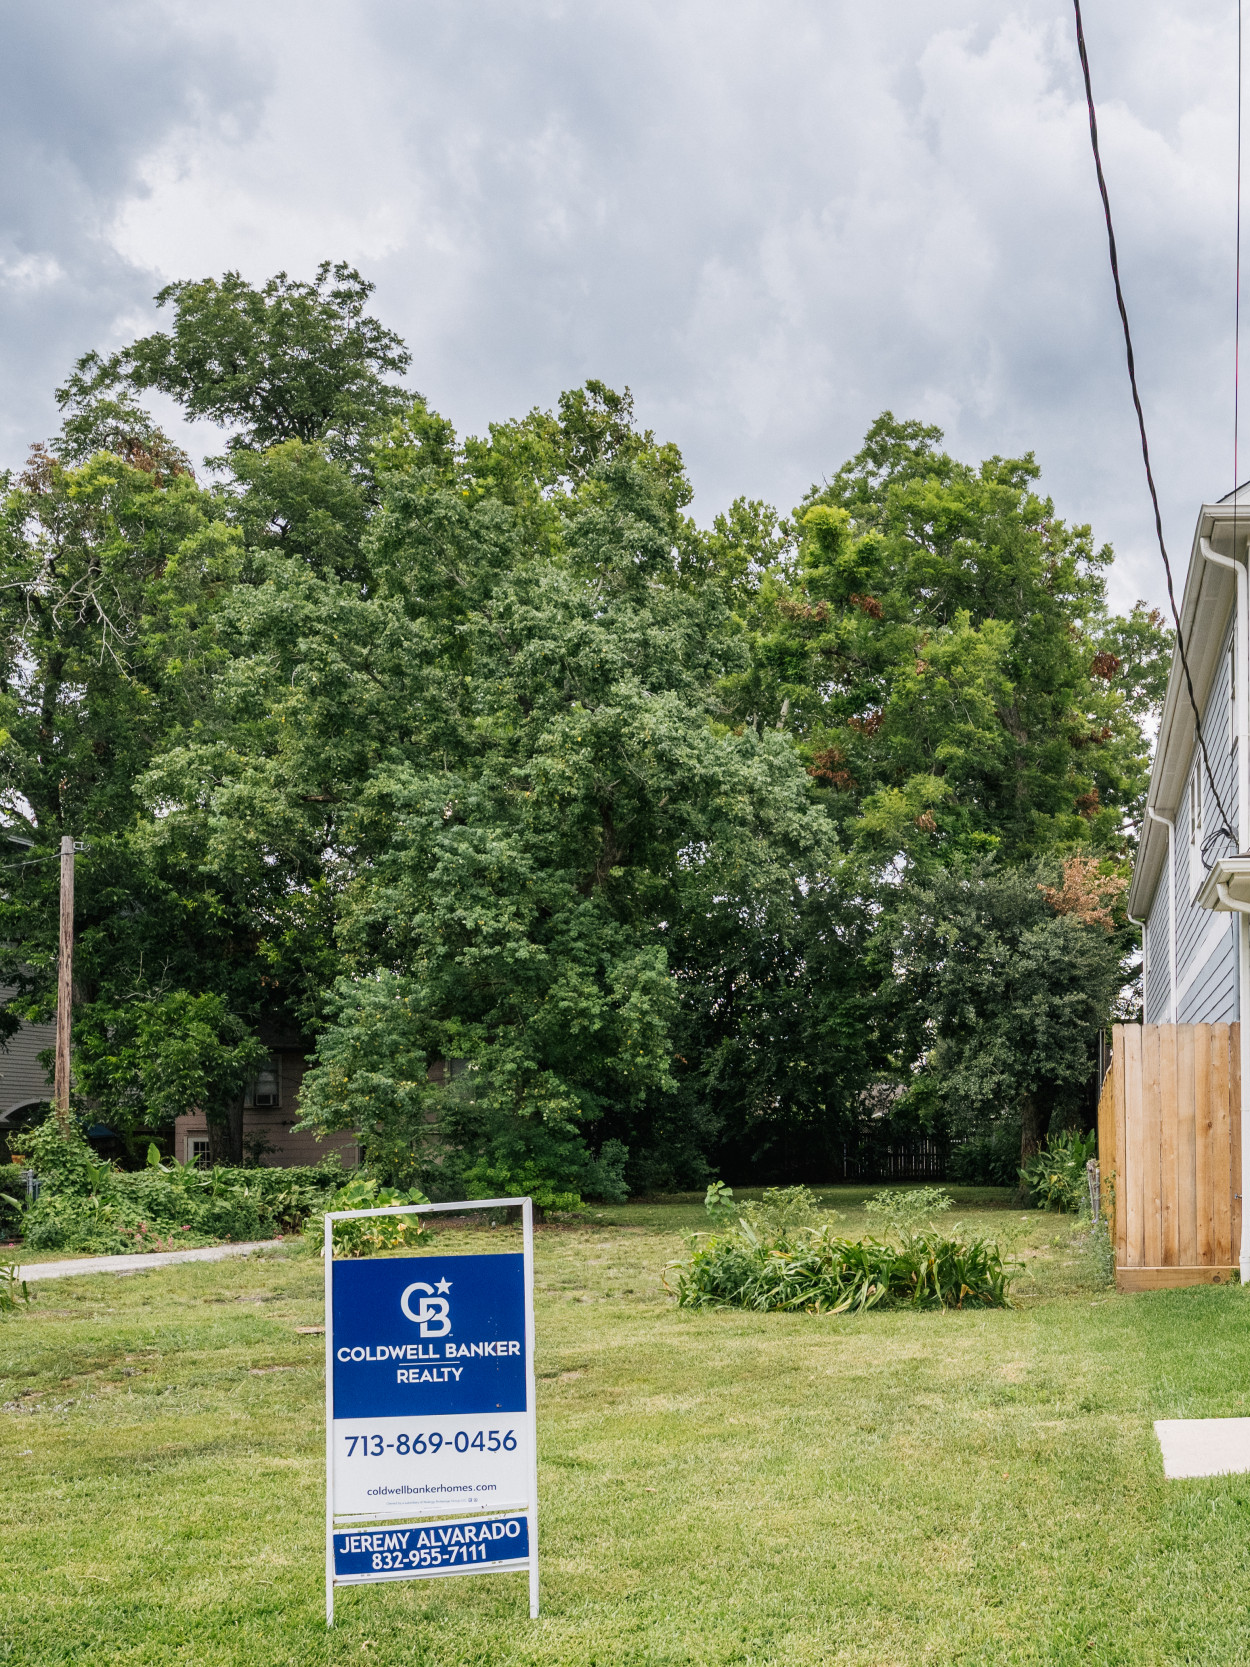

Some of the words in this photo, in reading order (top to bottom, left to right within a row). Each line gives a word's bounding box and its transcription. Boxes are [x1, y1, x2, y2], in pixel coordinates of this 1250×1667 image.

[337, 1344, 440, 1363] COLDWELL
[445, 1341, 521, 1358] BANKER
[396, 1367, 464, 1384] REALTY
[344, 1430, 518, 1457] 713-869-0456
[366, 1483, 497, 1496] coldwellbankerhomes.com
[339, 1531, 411, 1554] JEREMY
[416, 1520, 521, 1548] ALVARADO
[371, 1543, 487, 1570] 832-955-7111
